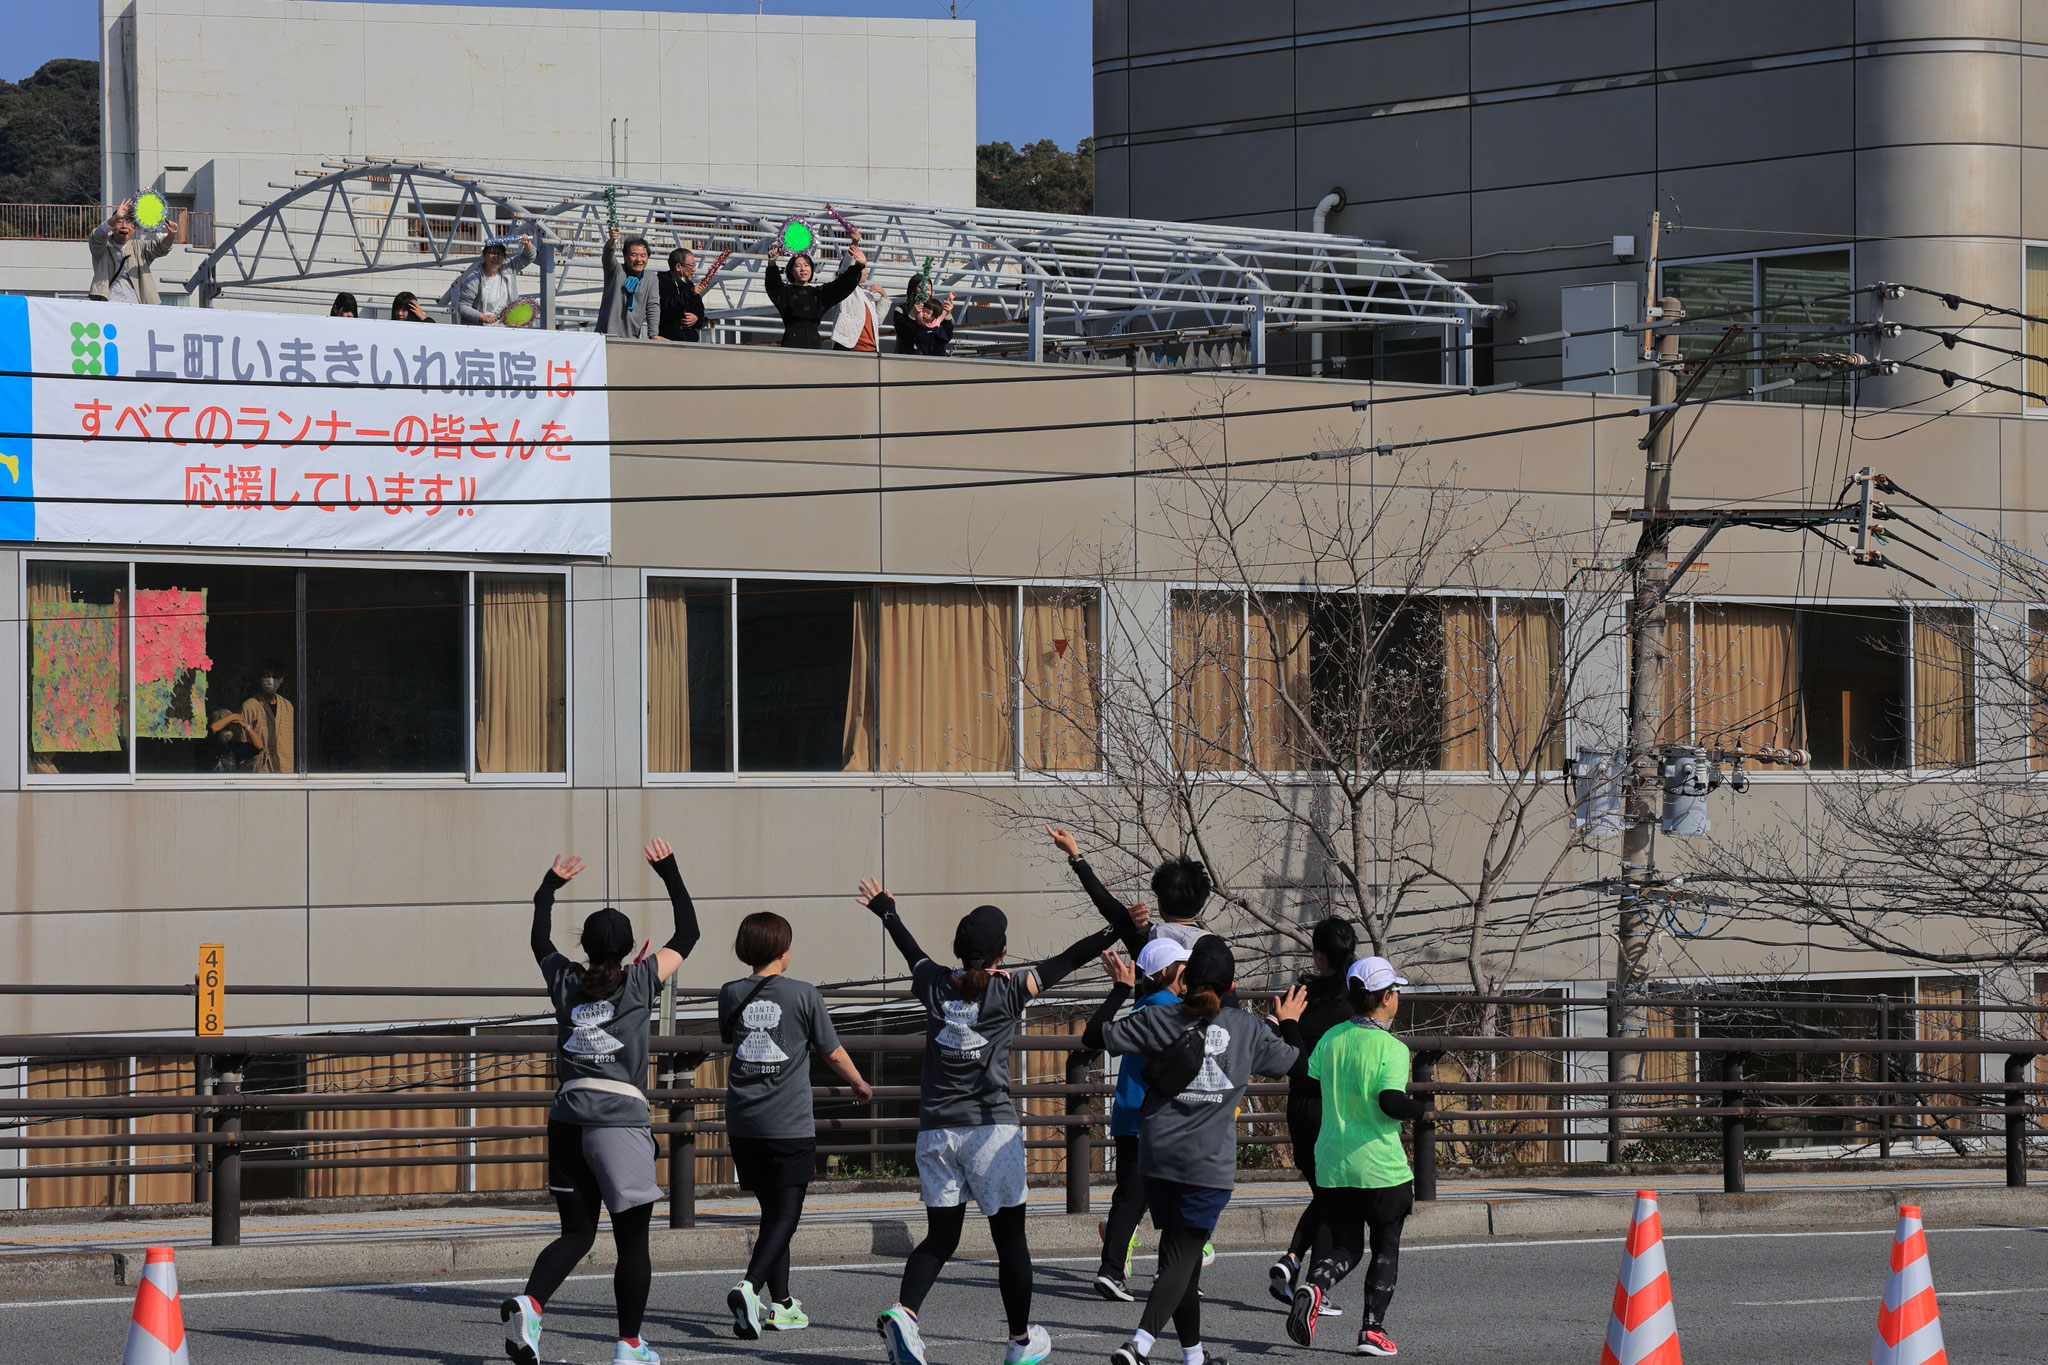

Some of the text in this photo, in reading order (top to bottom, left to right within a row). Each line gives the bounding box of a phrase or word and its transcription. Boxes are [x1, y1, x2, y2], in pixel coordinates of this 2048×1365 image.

[134, 329, 577, 400] 上町いまきいれ病院は
[73, 397, 574, 462] すべてのランナーの皆さんを
[594, 1054, 616, 1064] 2026
[961, 1050, 981, 1060] 2026
[761, 1065, 781, 1074] 2026
[1203, 1094, 1224, 1103] 2026
